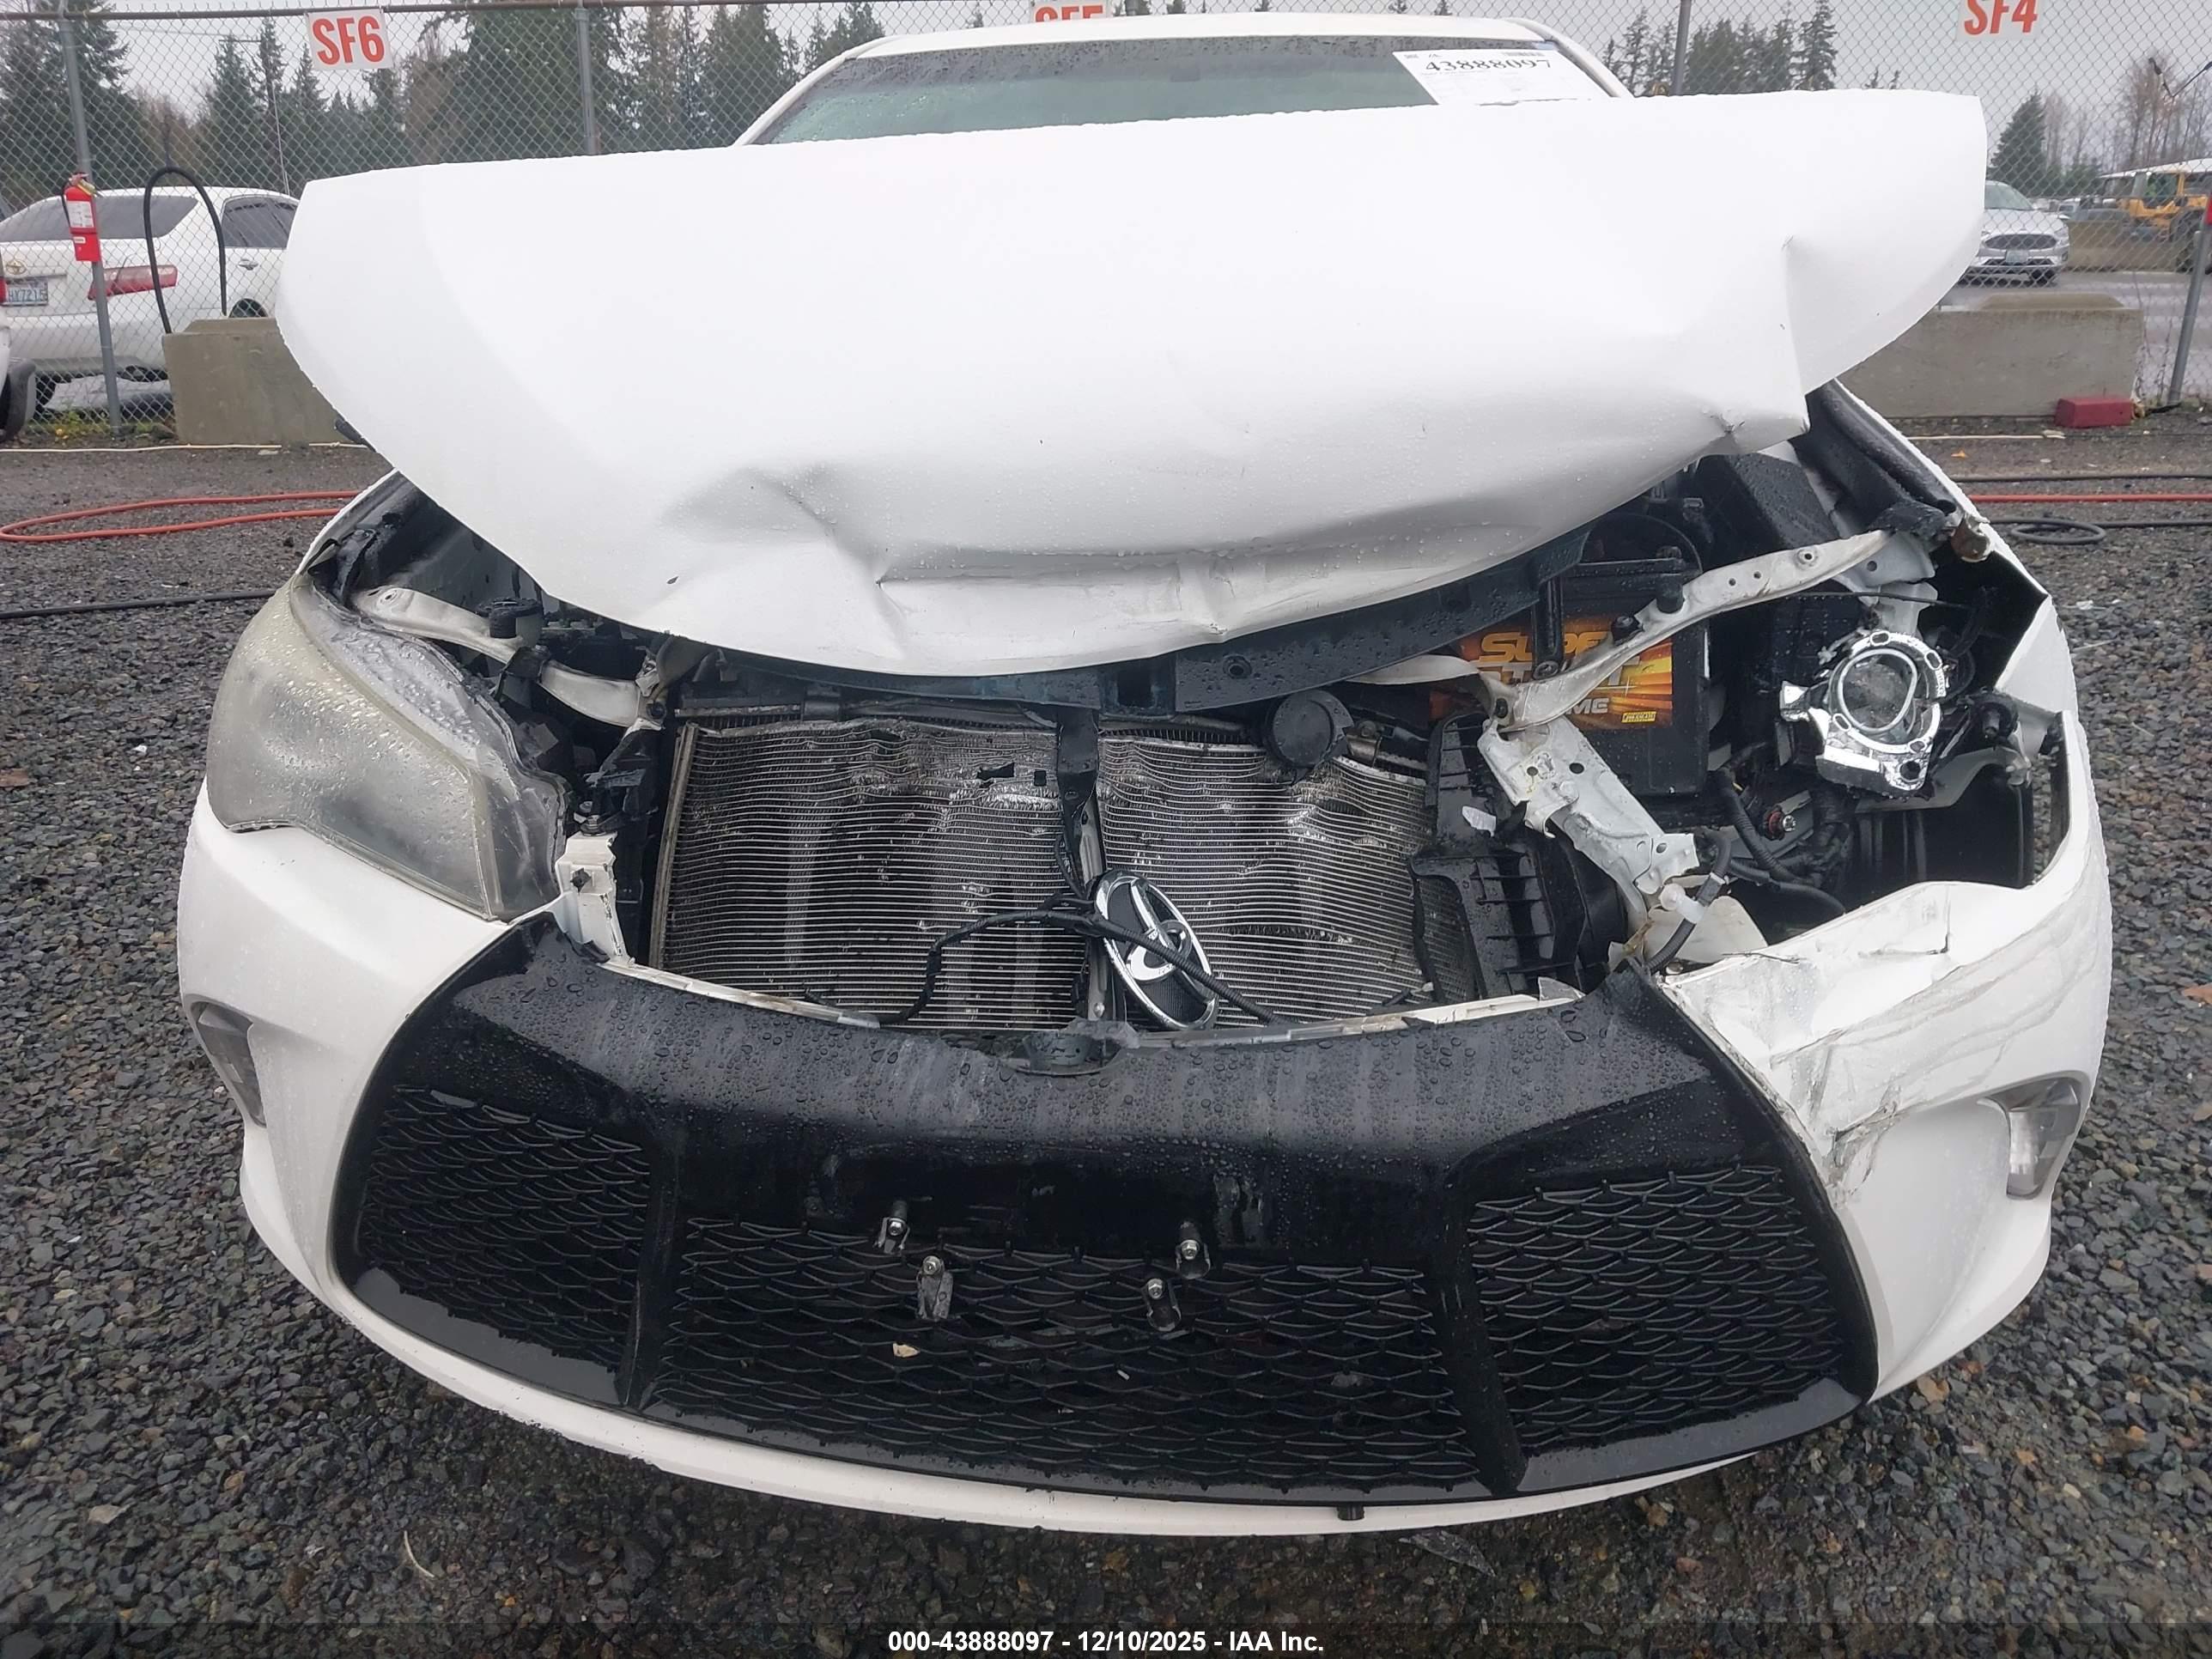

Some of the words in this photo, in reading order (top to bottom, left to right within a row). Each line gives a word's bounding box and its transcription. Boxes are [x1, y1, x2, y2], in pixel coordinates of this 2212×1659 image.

[1964, 0, 2039, 35] SF4
[312, 15, 385, 65] SF6
[1425, 59, 1552, 71] 43888097
